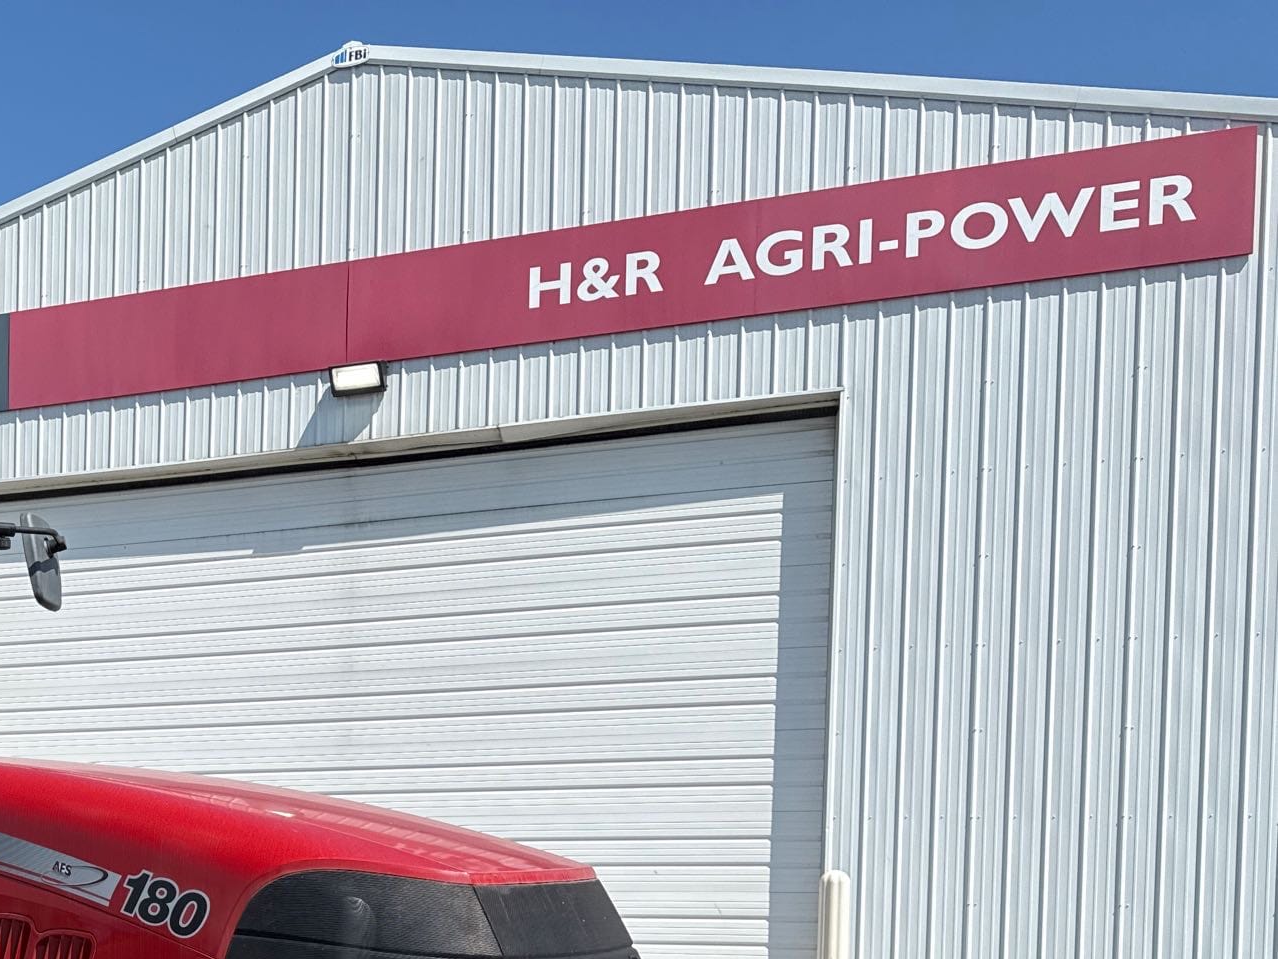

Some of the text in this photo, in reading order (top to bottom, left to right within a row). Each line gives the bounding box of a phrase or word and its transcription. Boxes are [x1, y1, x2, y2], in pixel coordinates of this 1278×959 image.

[528, 174, 1197, 309] H&R AGRI-POWER
[52, 860, 72, 877] AFS
[120, 868, 211, 939] 180
